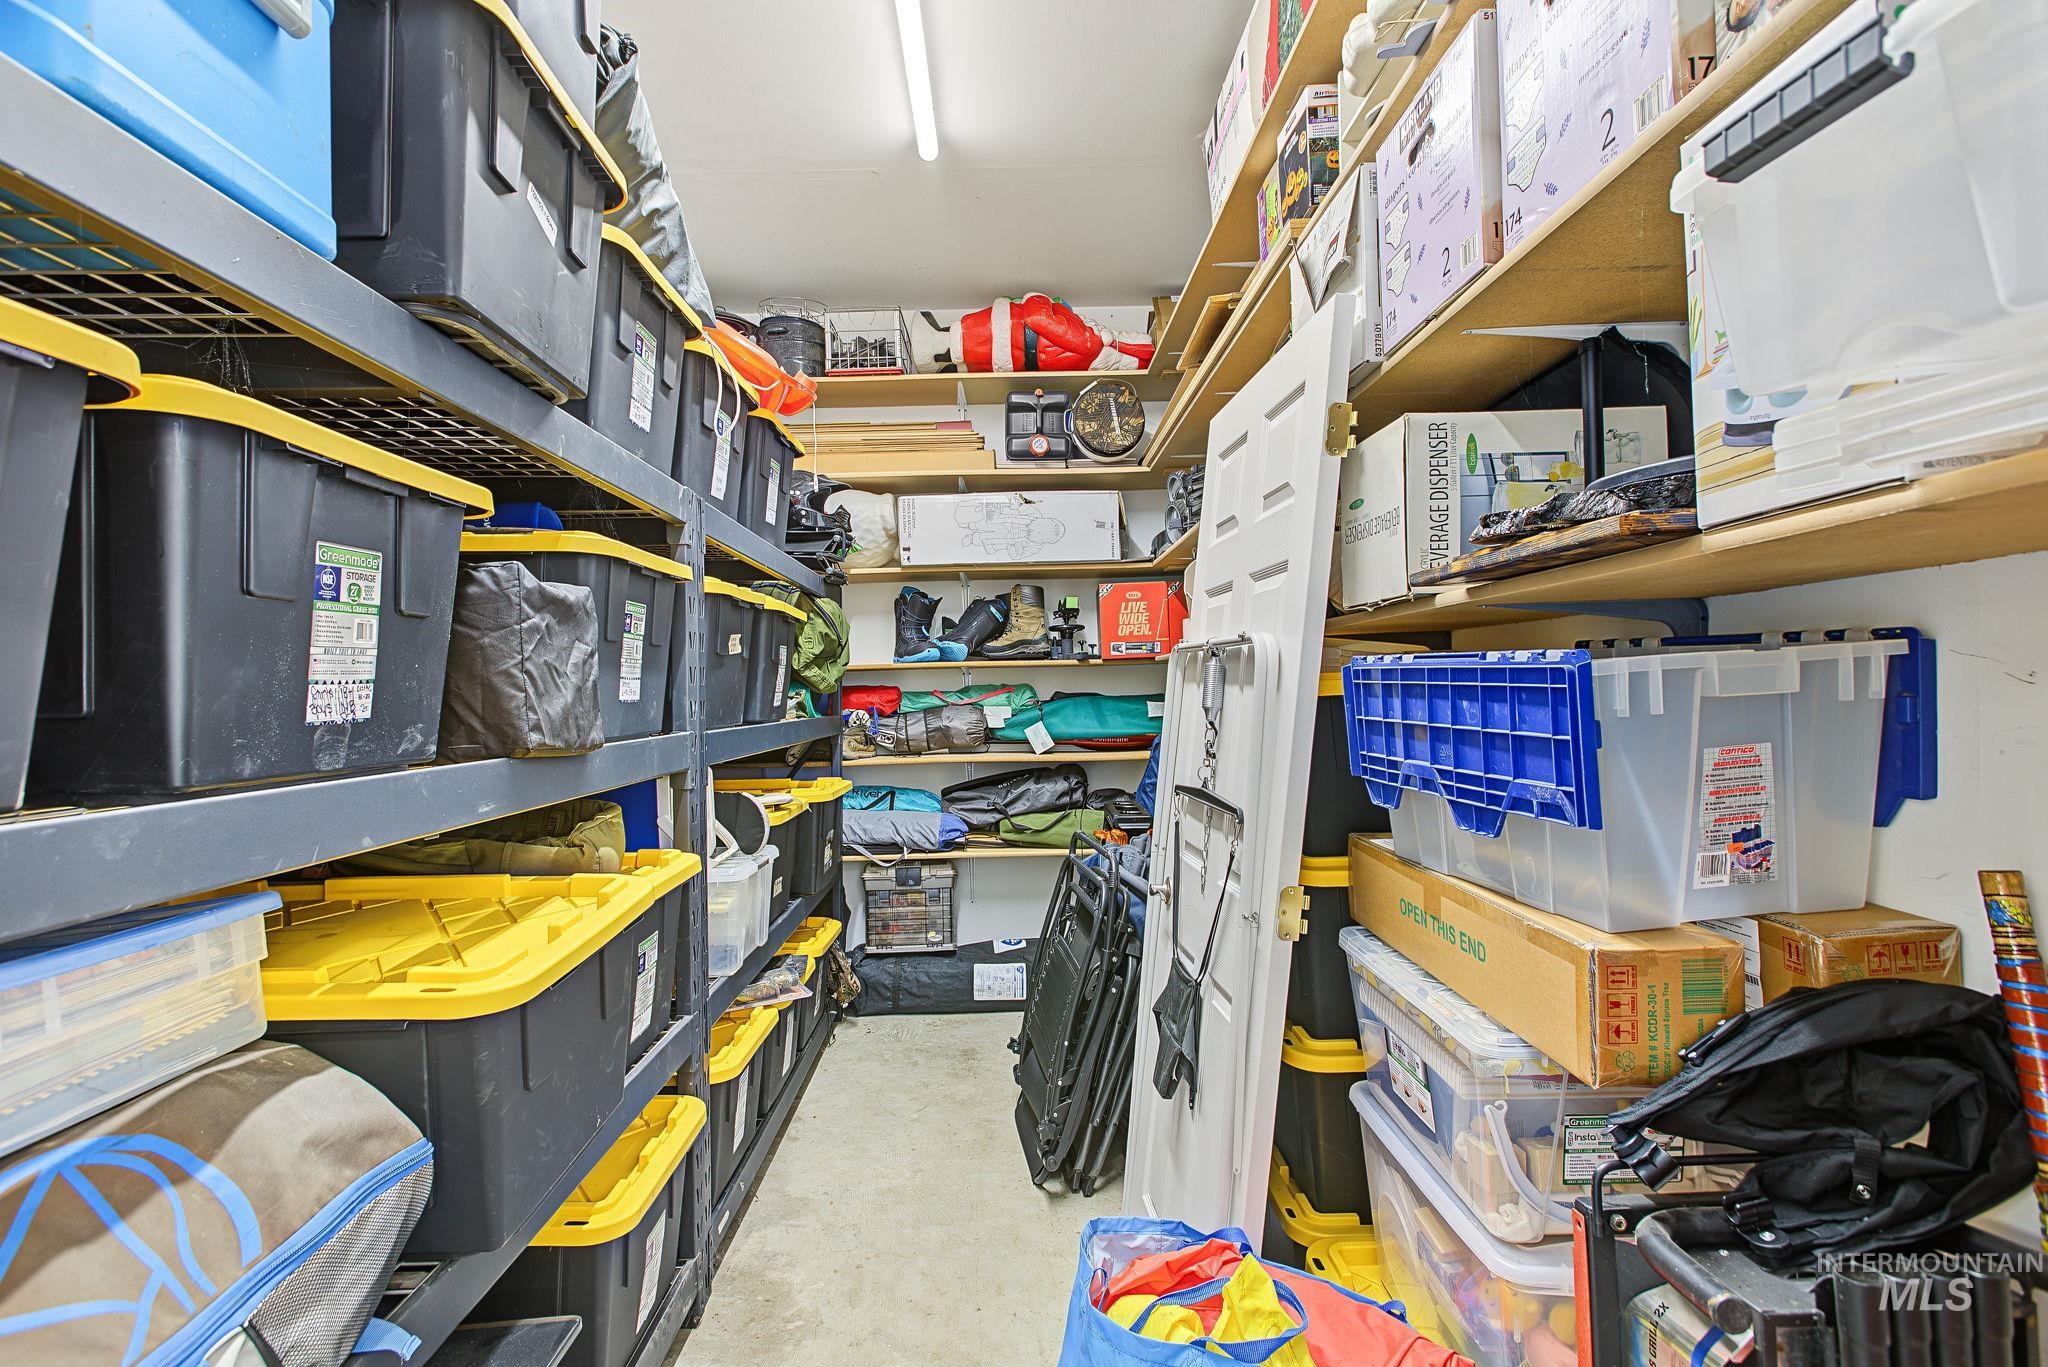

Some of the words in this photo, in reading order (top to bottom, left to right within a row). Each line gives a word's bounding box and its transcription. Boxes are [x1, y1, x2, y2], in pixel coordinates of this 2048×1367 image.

[1483, 11, 1496, 20] 51
[1600, 108, 1616, 151] 2
[1506, 207, 1523, 237] 174
[1442, 247, 1451, 277] 2
[1385, 308, 1397, 329] 174
[1428, 422, 1449, 500] DISPENSER
[1934, 455, 1985, 468] ATTENTION
[1429, 505, 1449, 568] EVERAGE
[319, 548, 379, 569] Greenmade
[346, 571, 377, 583] STORAGE
[1120, 601, 1148, 613] LIVE
[1119, 613, 1150, 625] WIDE
[1118, 624, 1152, 636] OPEN.
[1400, 898, 1427, 928] OPEN
[1429, 914, 1456, 945] THIS
[1459, 930, 1487, 962] END
[1647, 983, 1658, 1042] KCDR-30-1
[1570, 1118, 1606, 1126] Greenma
[1654, 1301, 1669, 1318] 2X
